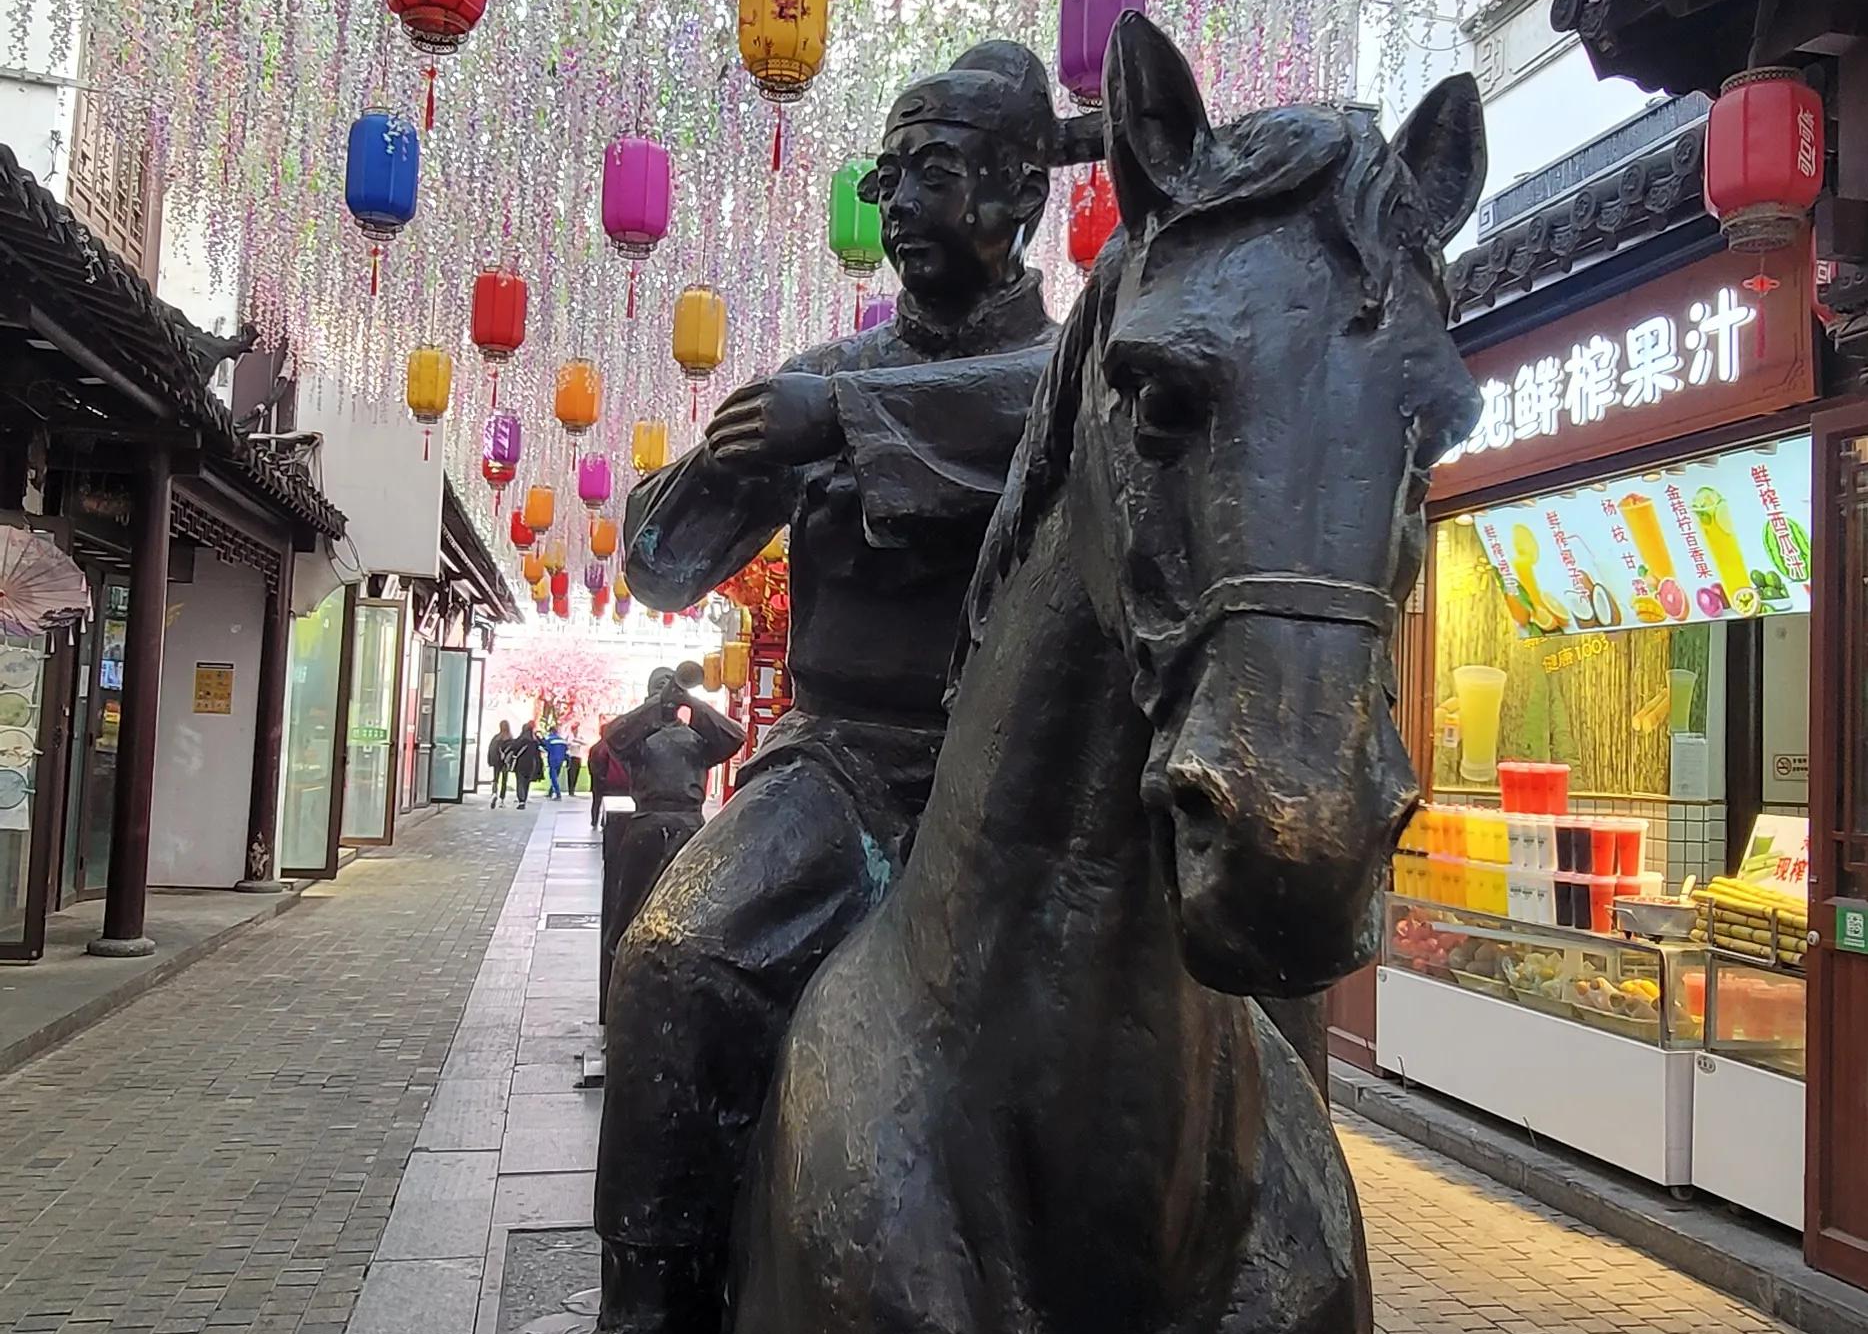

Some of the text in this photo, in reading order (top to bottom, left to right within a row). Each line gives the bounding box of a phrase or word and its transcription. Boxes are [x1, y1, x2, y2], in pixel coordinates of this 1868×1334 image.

[1429, 287, 1758, 467] 纯鲜榨果汁
[1601, 498, 1650, 597] 杨枝甘露
[1664, 483, 1714, 579] 金桔柠百香果
[1751, 464, 1806, 581] 鲜榨西瓜汁
